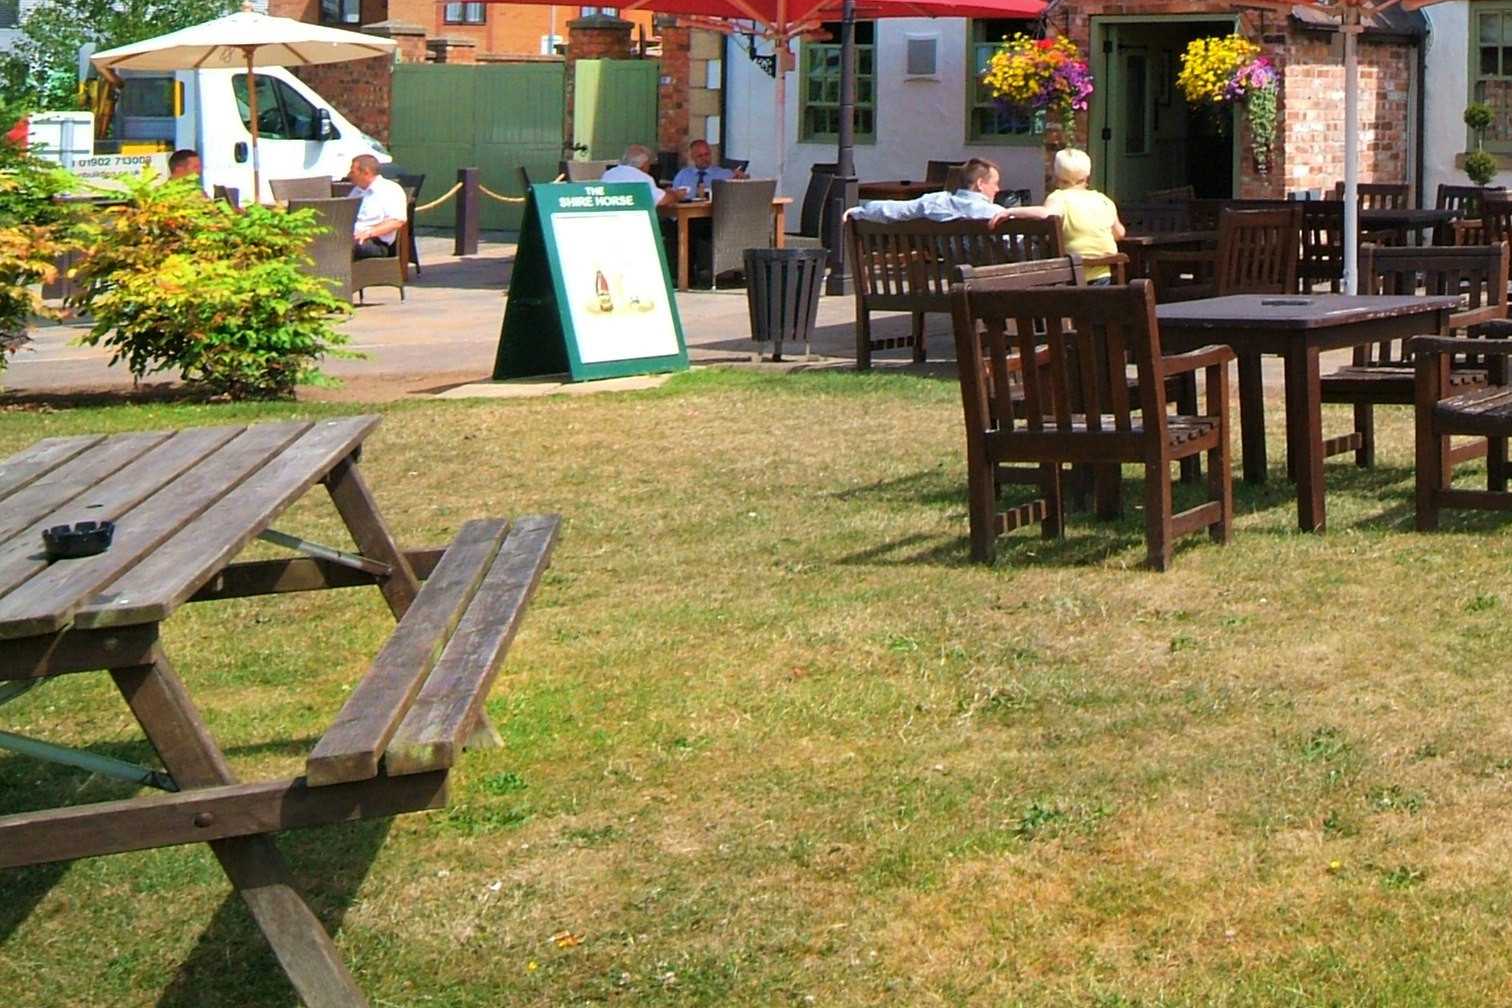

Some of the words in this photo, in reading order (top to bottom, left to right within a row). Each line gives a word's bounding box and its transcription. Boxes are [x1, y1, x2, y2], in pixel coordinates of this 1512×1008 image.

[79, 157, 111, 168] 01902
[584, 186, 605, 196] THE
[559, 196, 594, 208] SHIRE
[595, 195, 634, 207] HORSE
